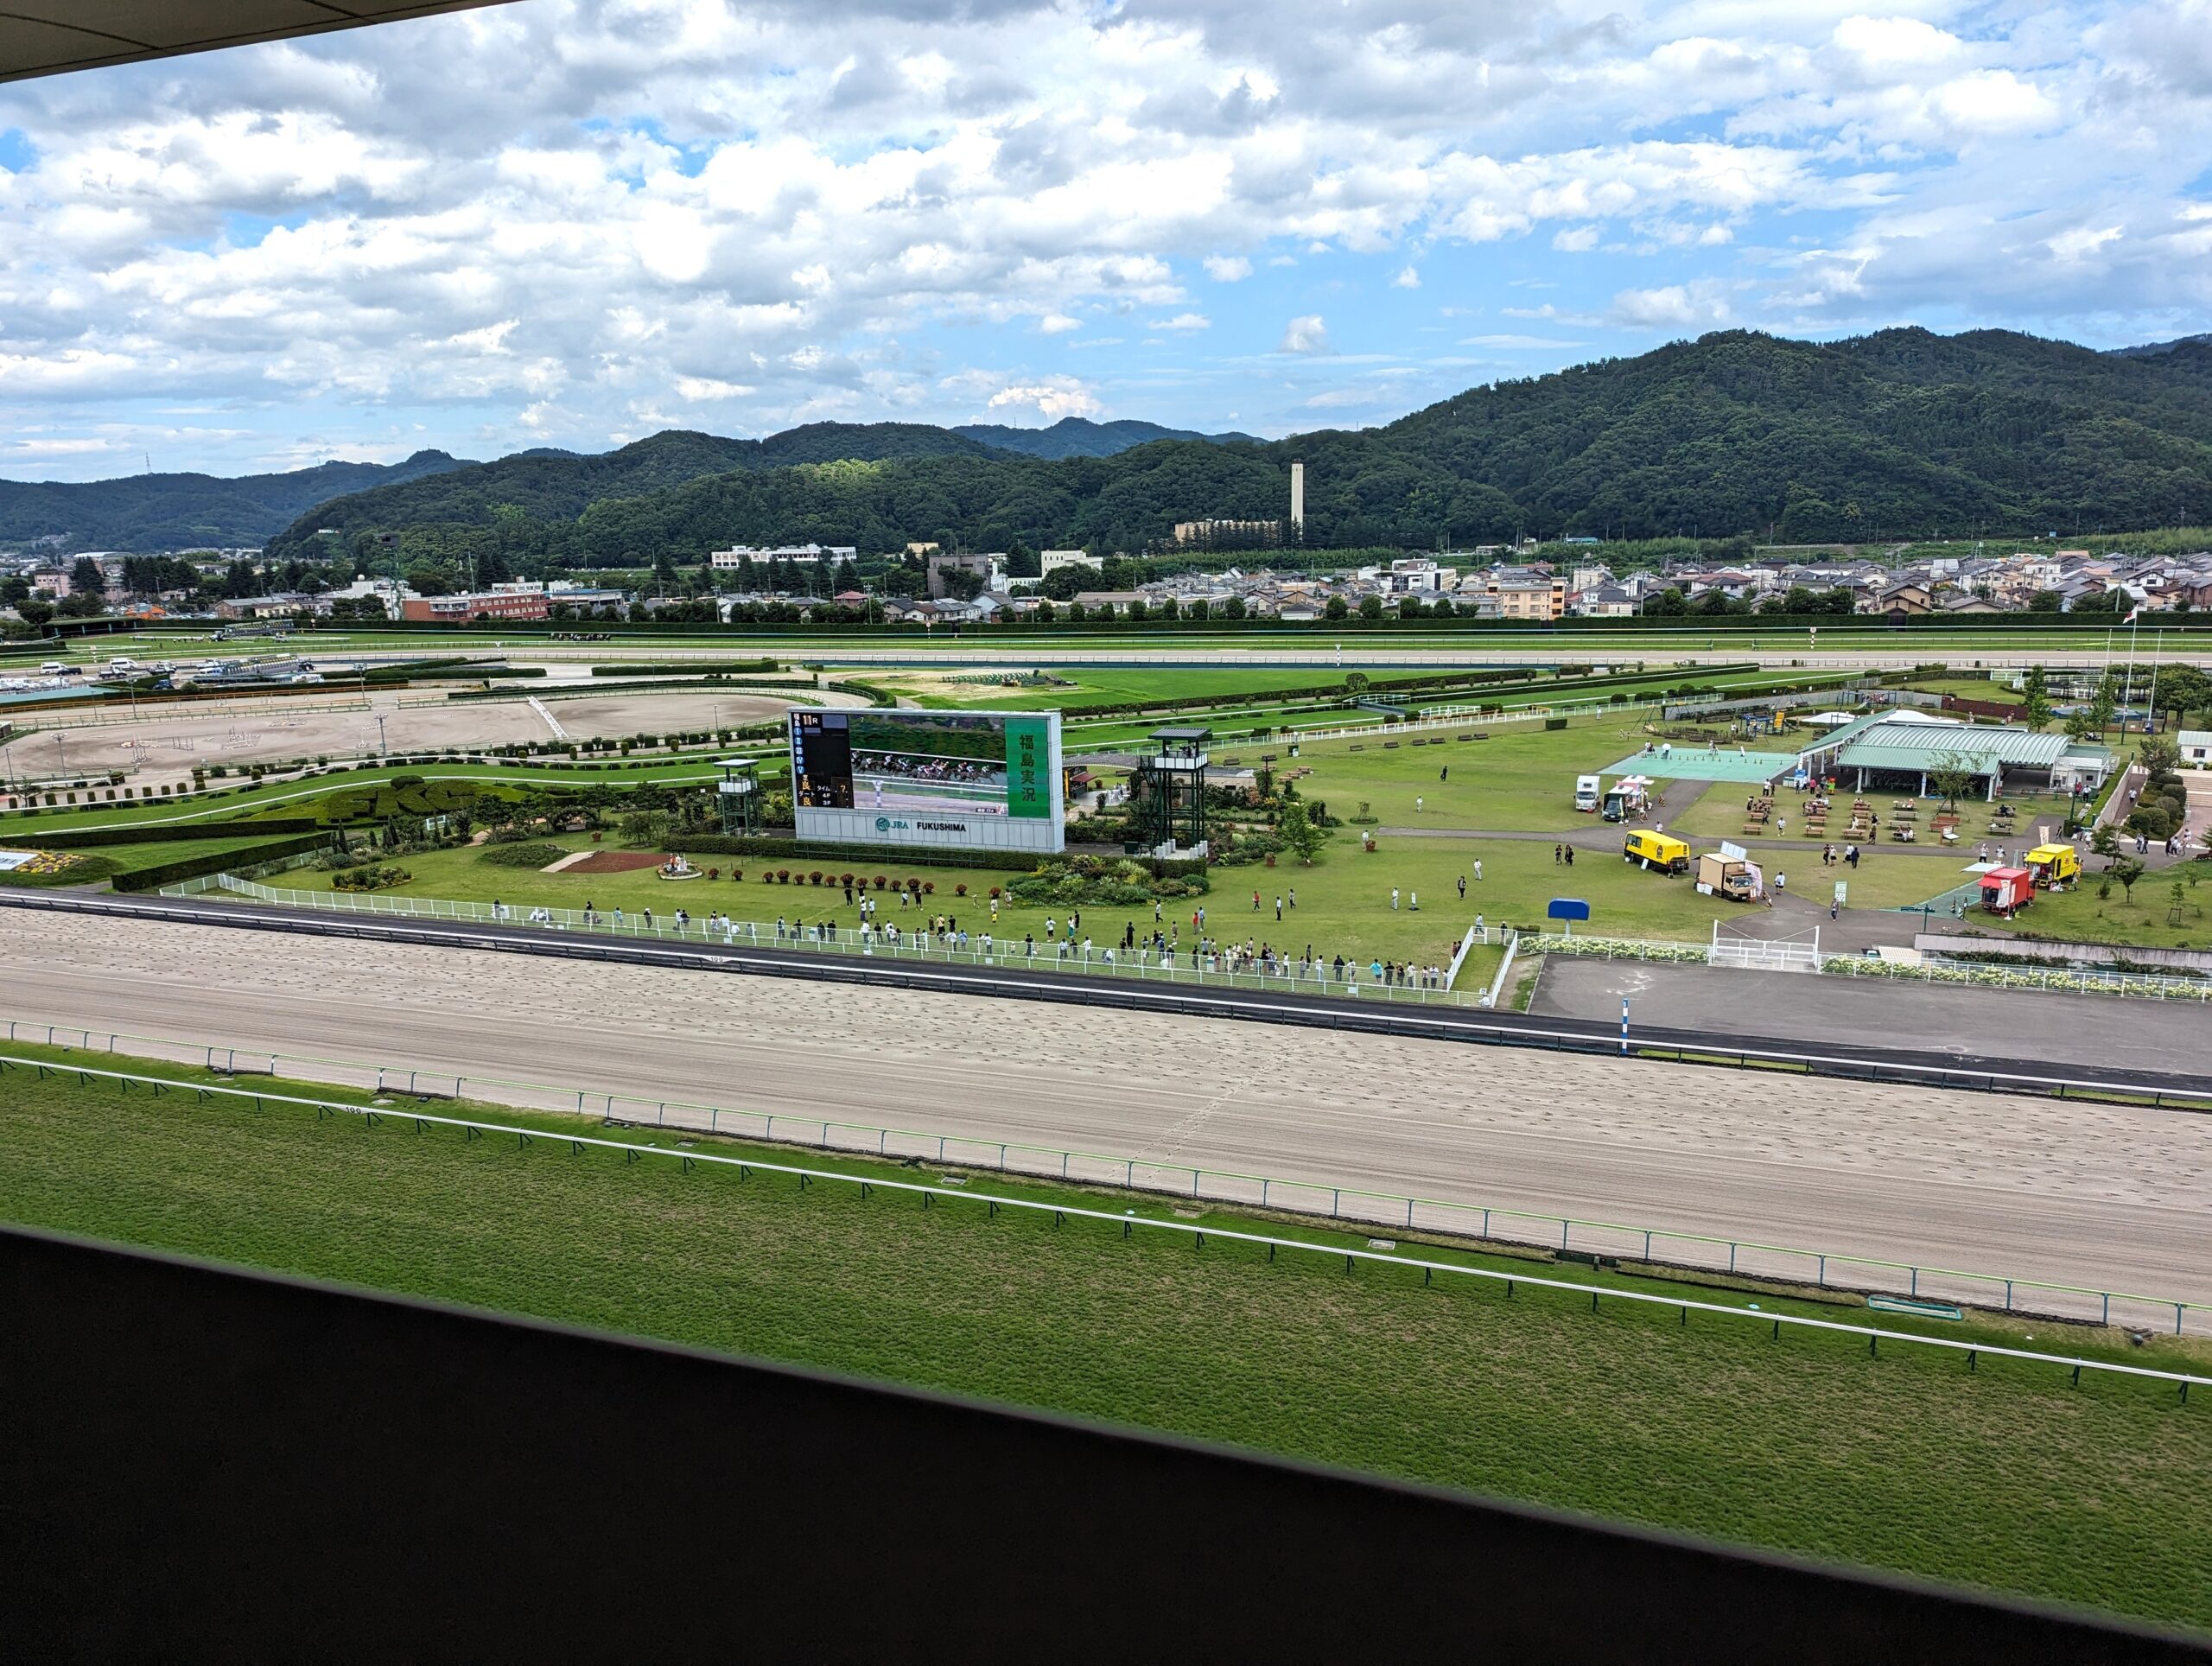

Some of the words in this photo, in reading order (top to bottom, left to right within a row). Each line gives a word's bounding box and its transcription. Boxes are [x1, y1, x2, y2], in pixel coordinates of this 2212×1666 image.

[1019, 734, 1036, 802] 福島実況
[917, 822, 966, 832] FUKUSHIMA
